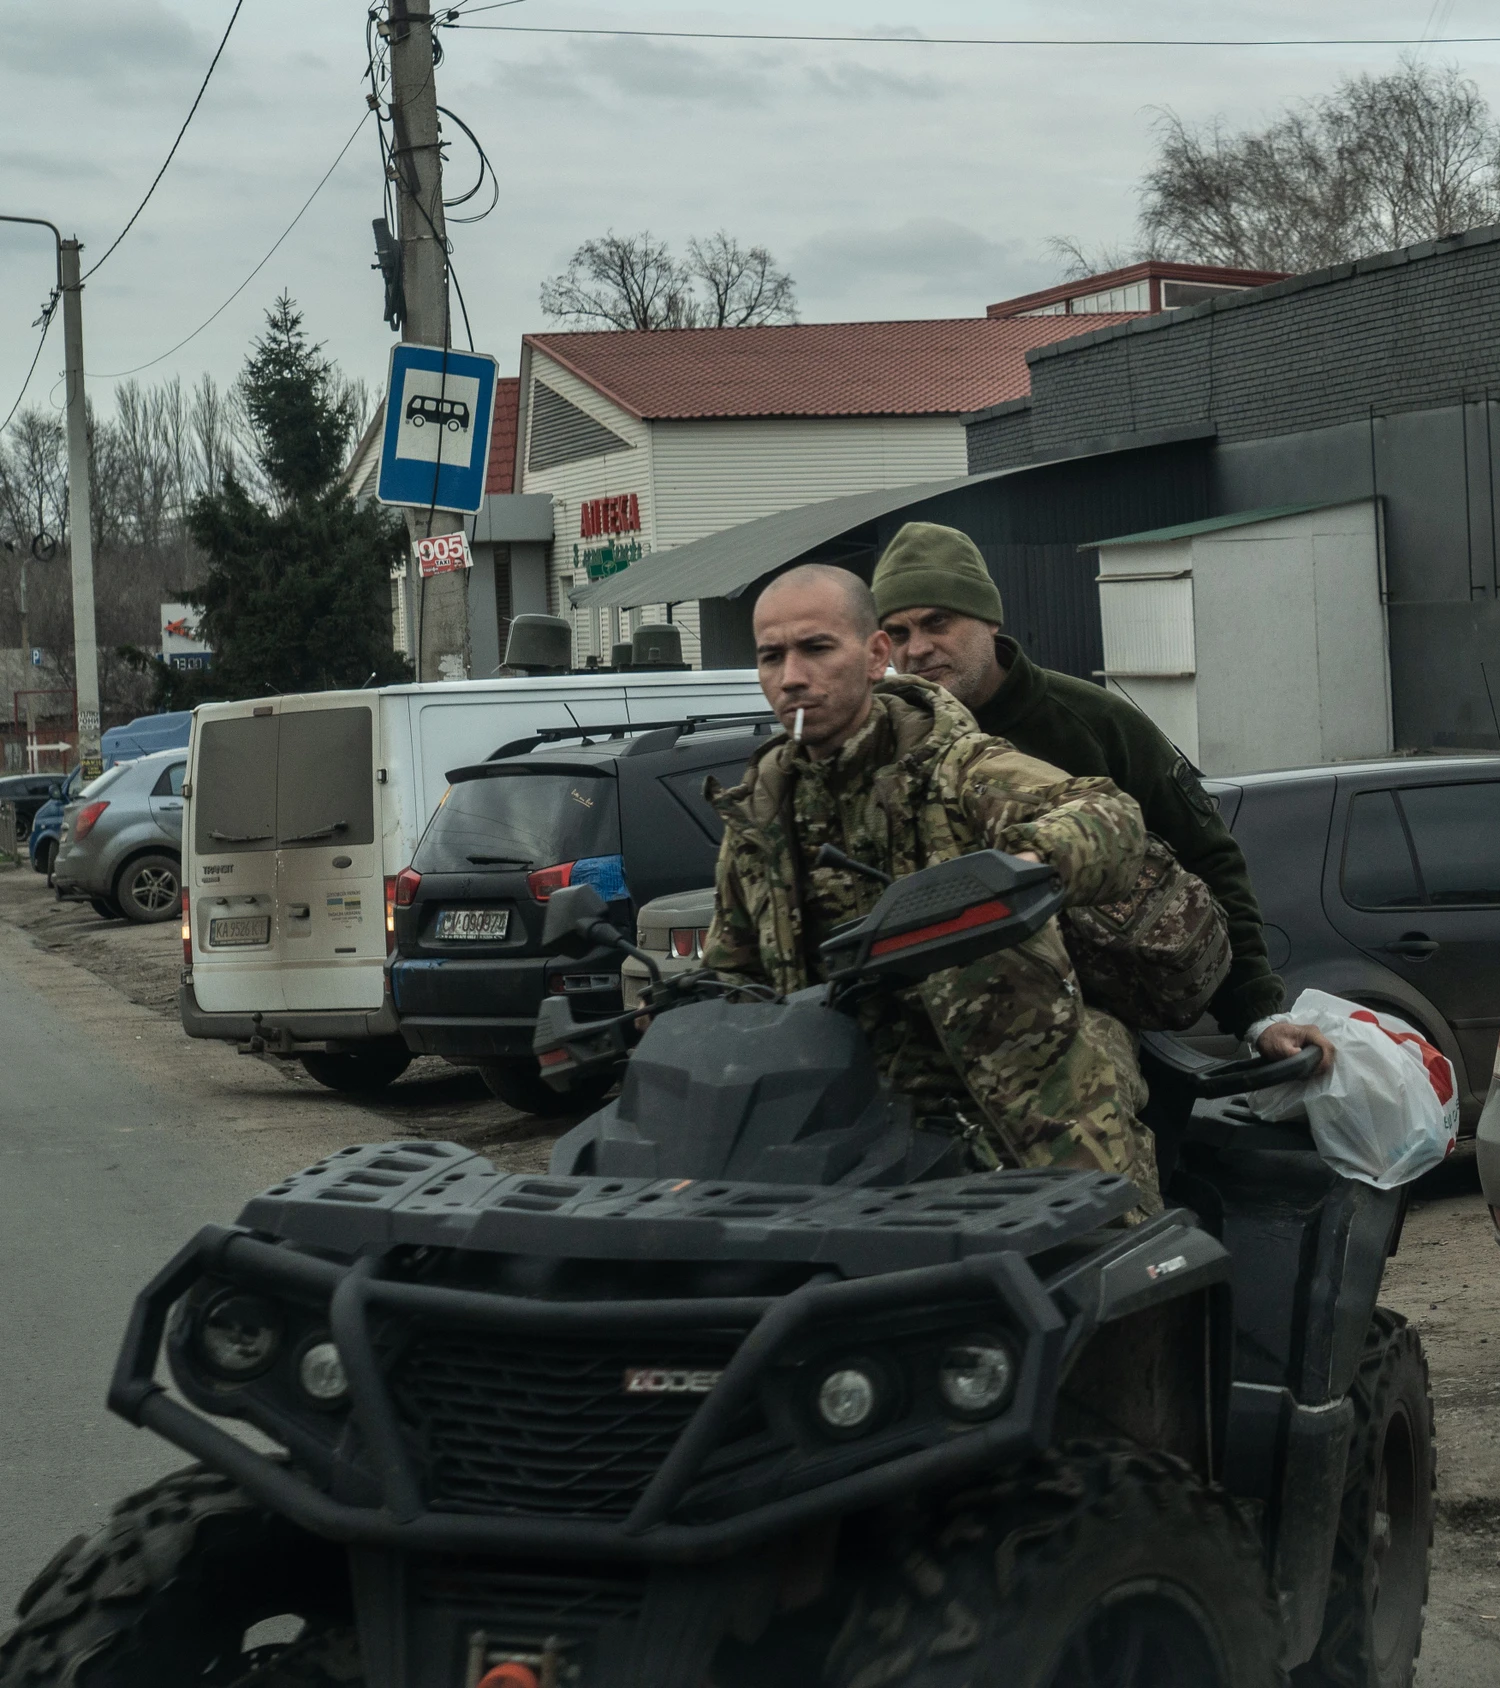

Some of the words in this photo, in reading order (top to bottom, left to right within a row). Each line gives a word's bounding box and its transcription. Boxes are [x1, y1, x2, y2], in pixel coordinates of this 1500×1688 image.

[580, 493, 641, 538] АПТЕКА
[420, 537, 463, 561] 905
[33, 649, 40, 665] P
